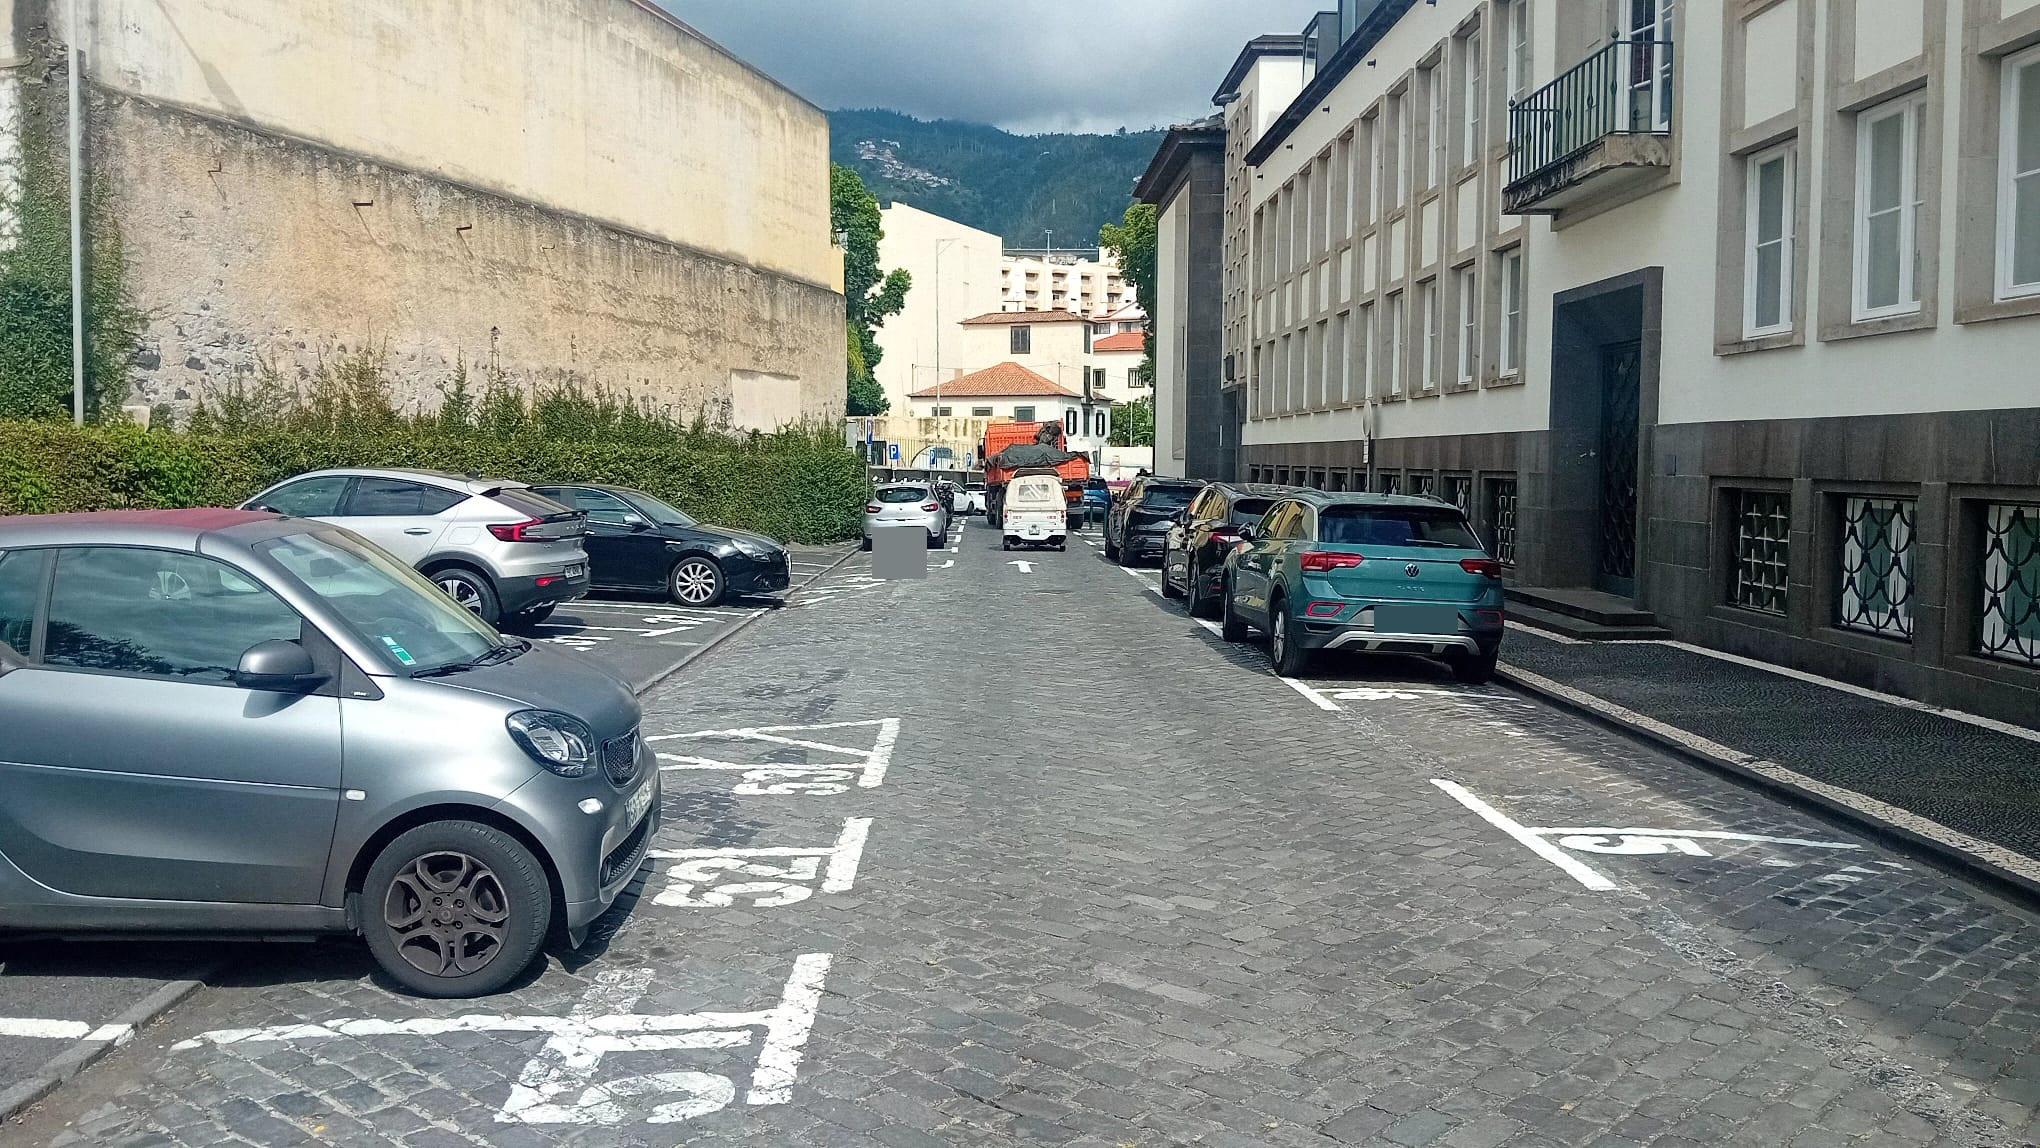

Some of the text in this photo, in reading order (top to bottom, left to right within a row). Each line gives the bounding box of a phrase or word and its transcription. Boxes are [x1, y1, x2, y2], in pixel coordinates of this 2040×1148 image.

[732, 769, 854, 795] 53
[1559, 835, 1713, 857] 5
[651, 856, 821, 907] 52
